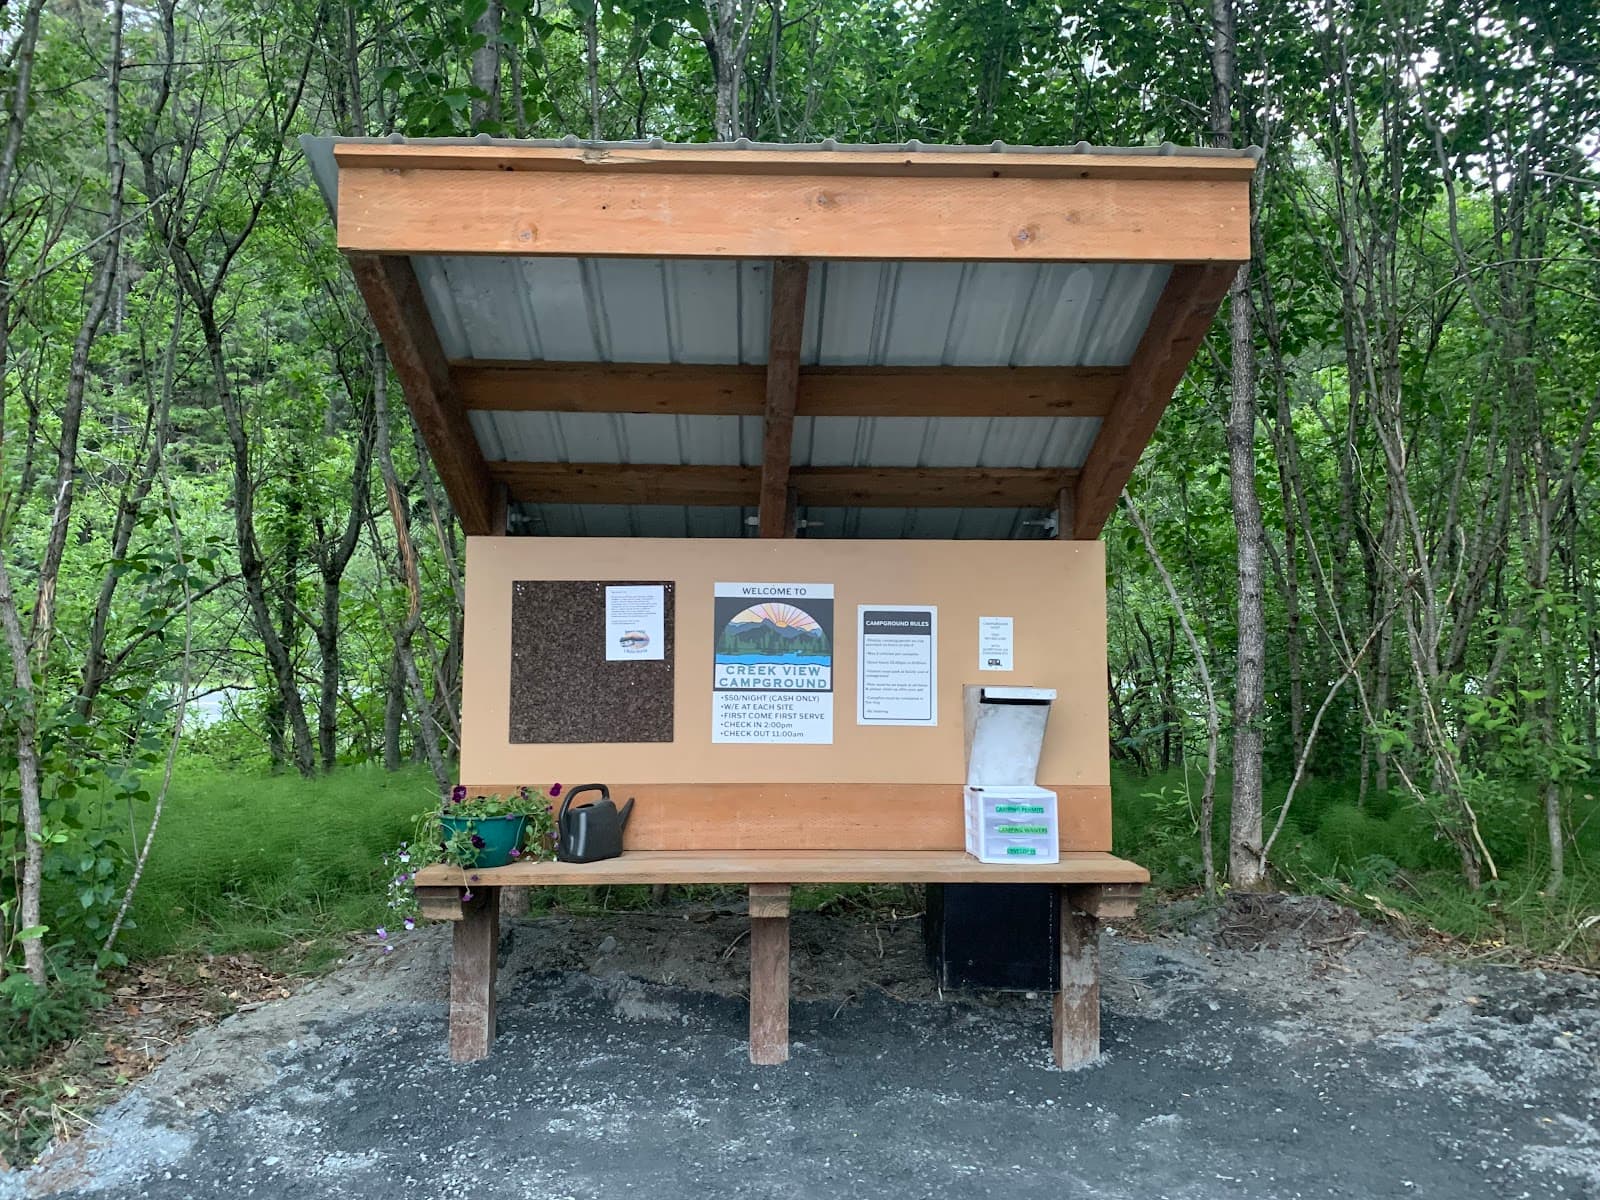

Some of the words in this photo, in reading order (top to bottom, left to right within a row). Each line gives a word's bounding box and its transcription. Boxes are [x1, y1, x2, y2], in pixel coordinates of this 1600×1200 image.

[742, 587, 792, 596] WELCOME
[794, 587, 807, 596] TO
[726, 665, 777, 676] CREEK
[782, 666, 821, 677] VIEW
[719, 677, 827, 689] CAMPGROUND
[768, 694, 794, 703] (CASH
[795, 695, 820, 704] ONLY)
[741, 703, 751, 711] AT
[752, 703, 775, 711] EACH
[724, 712, 747, 720] FIRST
[748, 712, 773, 720] COME
[764, 721, 793, 730] 2:00pm
